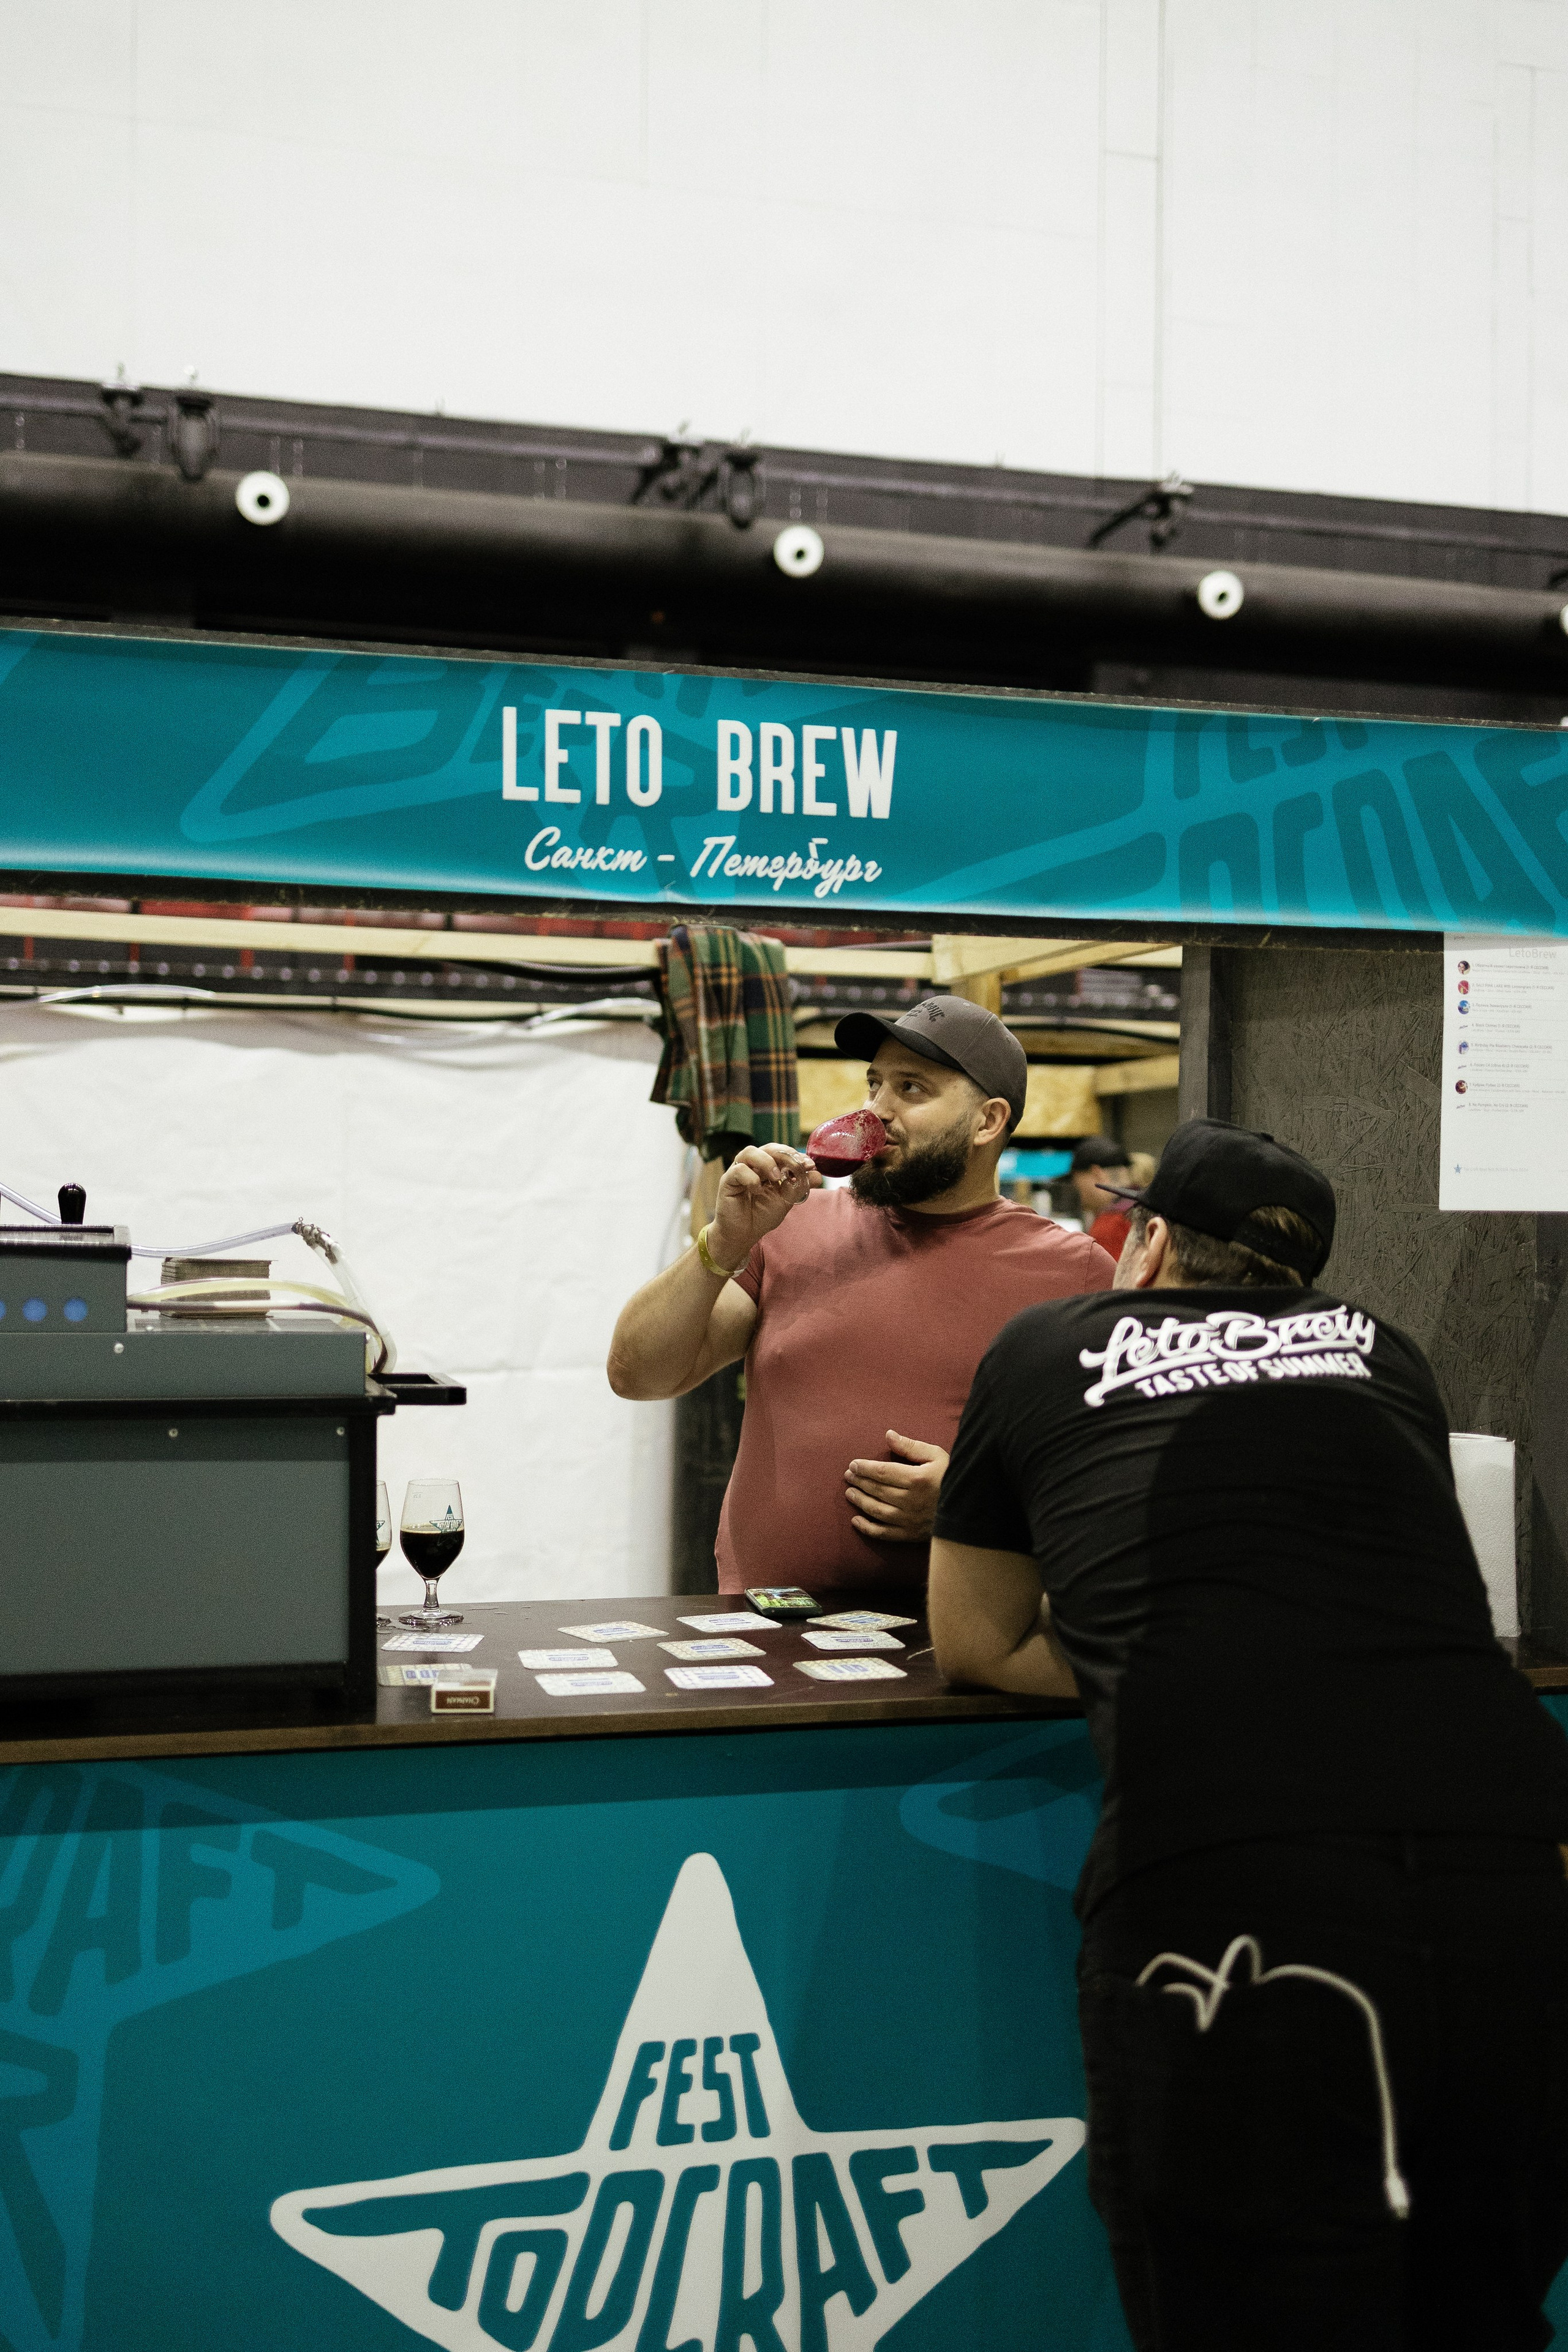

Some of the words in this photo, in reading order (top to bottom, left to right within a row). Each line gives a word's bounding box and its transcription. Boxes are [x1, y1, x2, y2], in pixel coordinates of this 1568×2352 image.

[502, 706, 662, 807] LETO
[717, 719, 897, 819] BREW
[524, 826, 647, 872] Санкт
[690, 834, 883, 899] Петербург
[1509, 949, 1556, 959] LetoBrew
[1134, 1361, 1228, 1398] TASTE
[1223, 1359, 1259, 1383] OF
[1257, 1352, 1372, 1379] SUMMER
[608, 2032, 771, 2152] FEST
